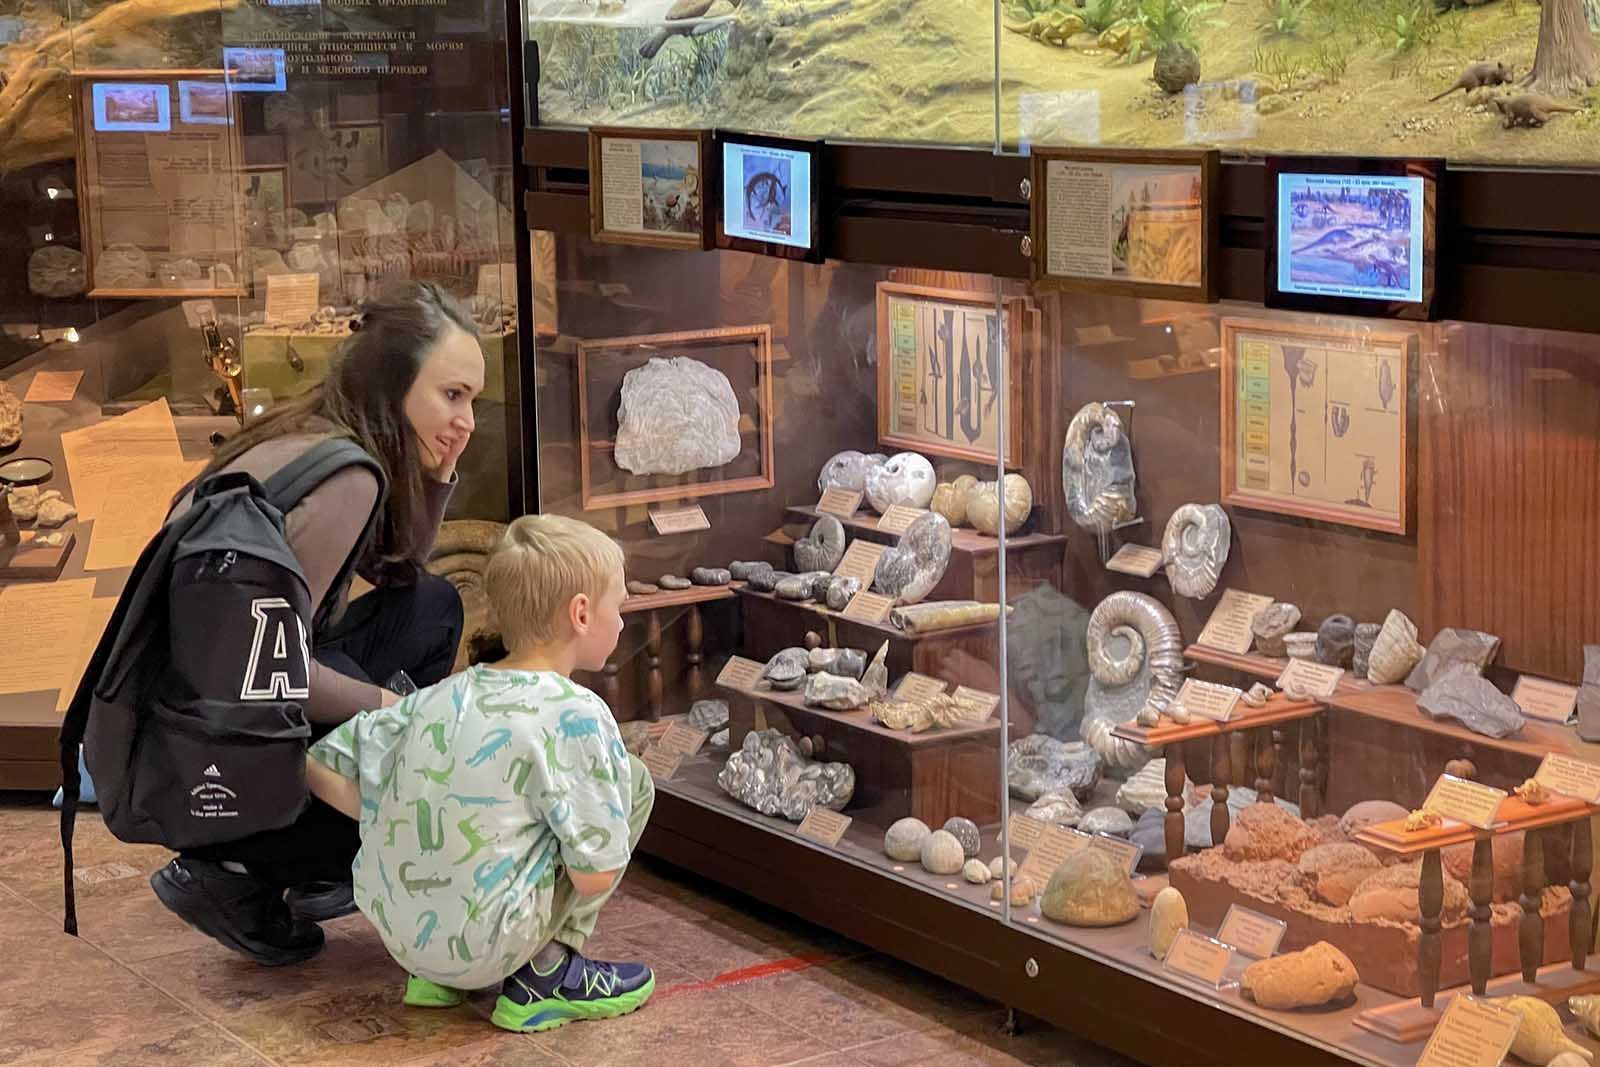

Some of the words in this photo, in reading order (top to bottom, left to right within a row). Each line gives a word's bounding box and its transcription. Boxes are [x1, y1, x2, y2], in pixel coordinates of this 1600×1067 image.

[343, 32, 416, 40] ВСТРЕЧАЮТСЯ
[320, 42, 397, 51] ОТНОСЯЩИЕСЯ
[426, 42, 464, 50] МОРЯМ
[317, 65, 370, 74] МЕЛОВОГО
[377, 65, 428, 74] ПЕРИОДОВ
[240, 597, 309, 700] A
